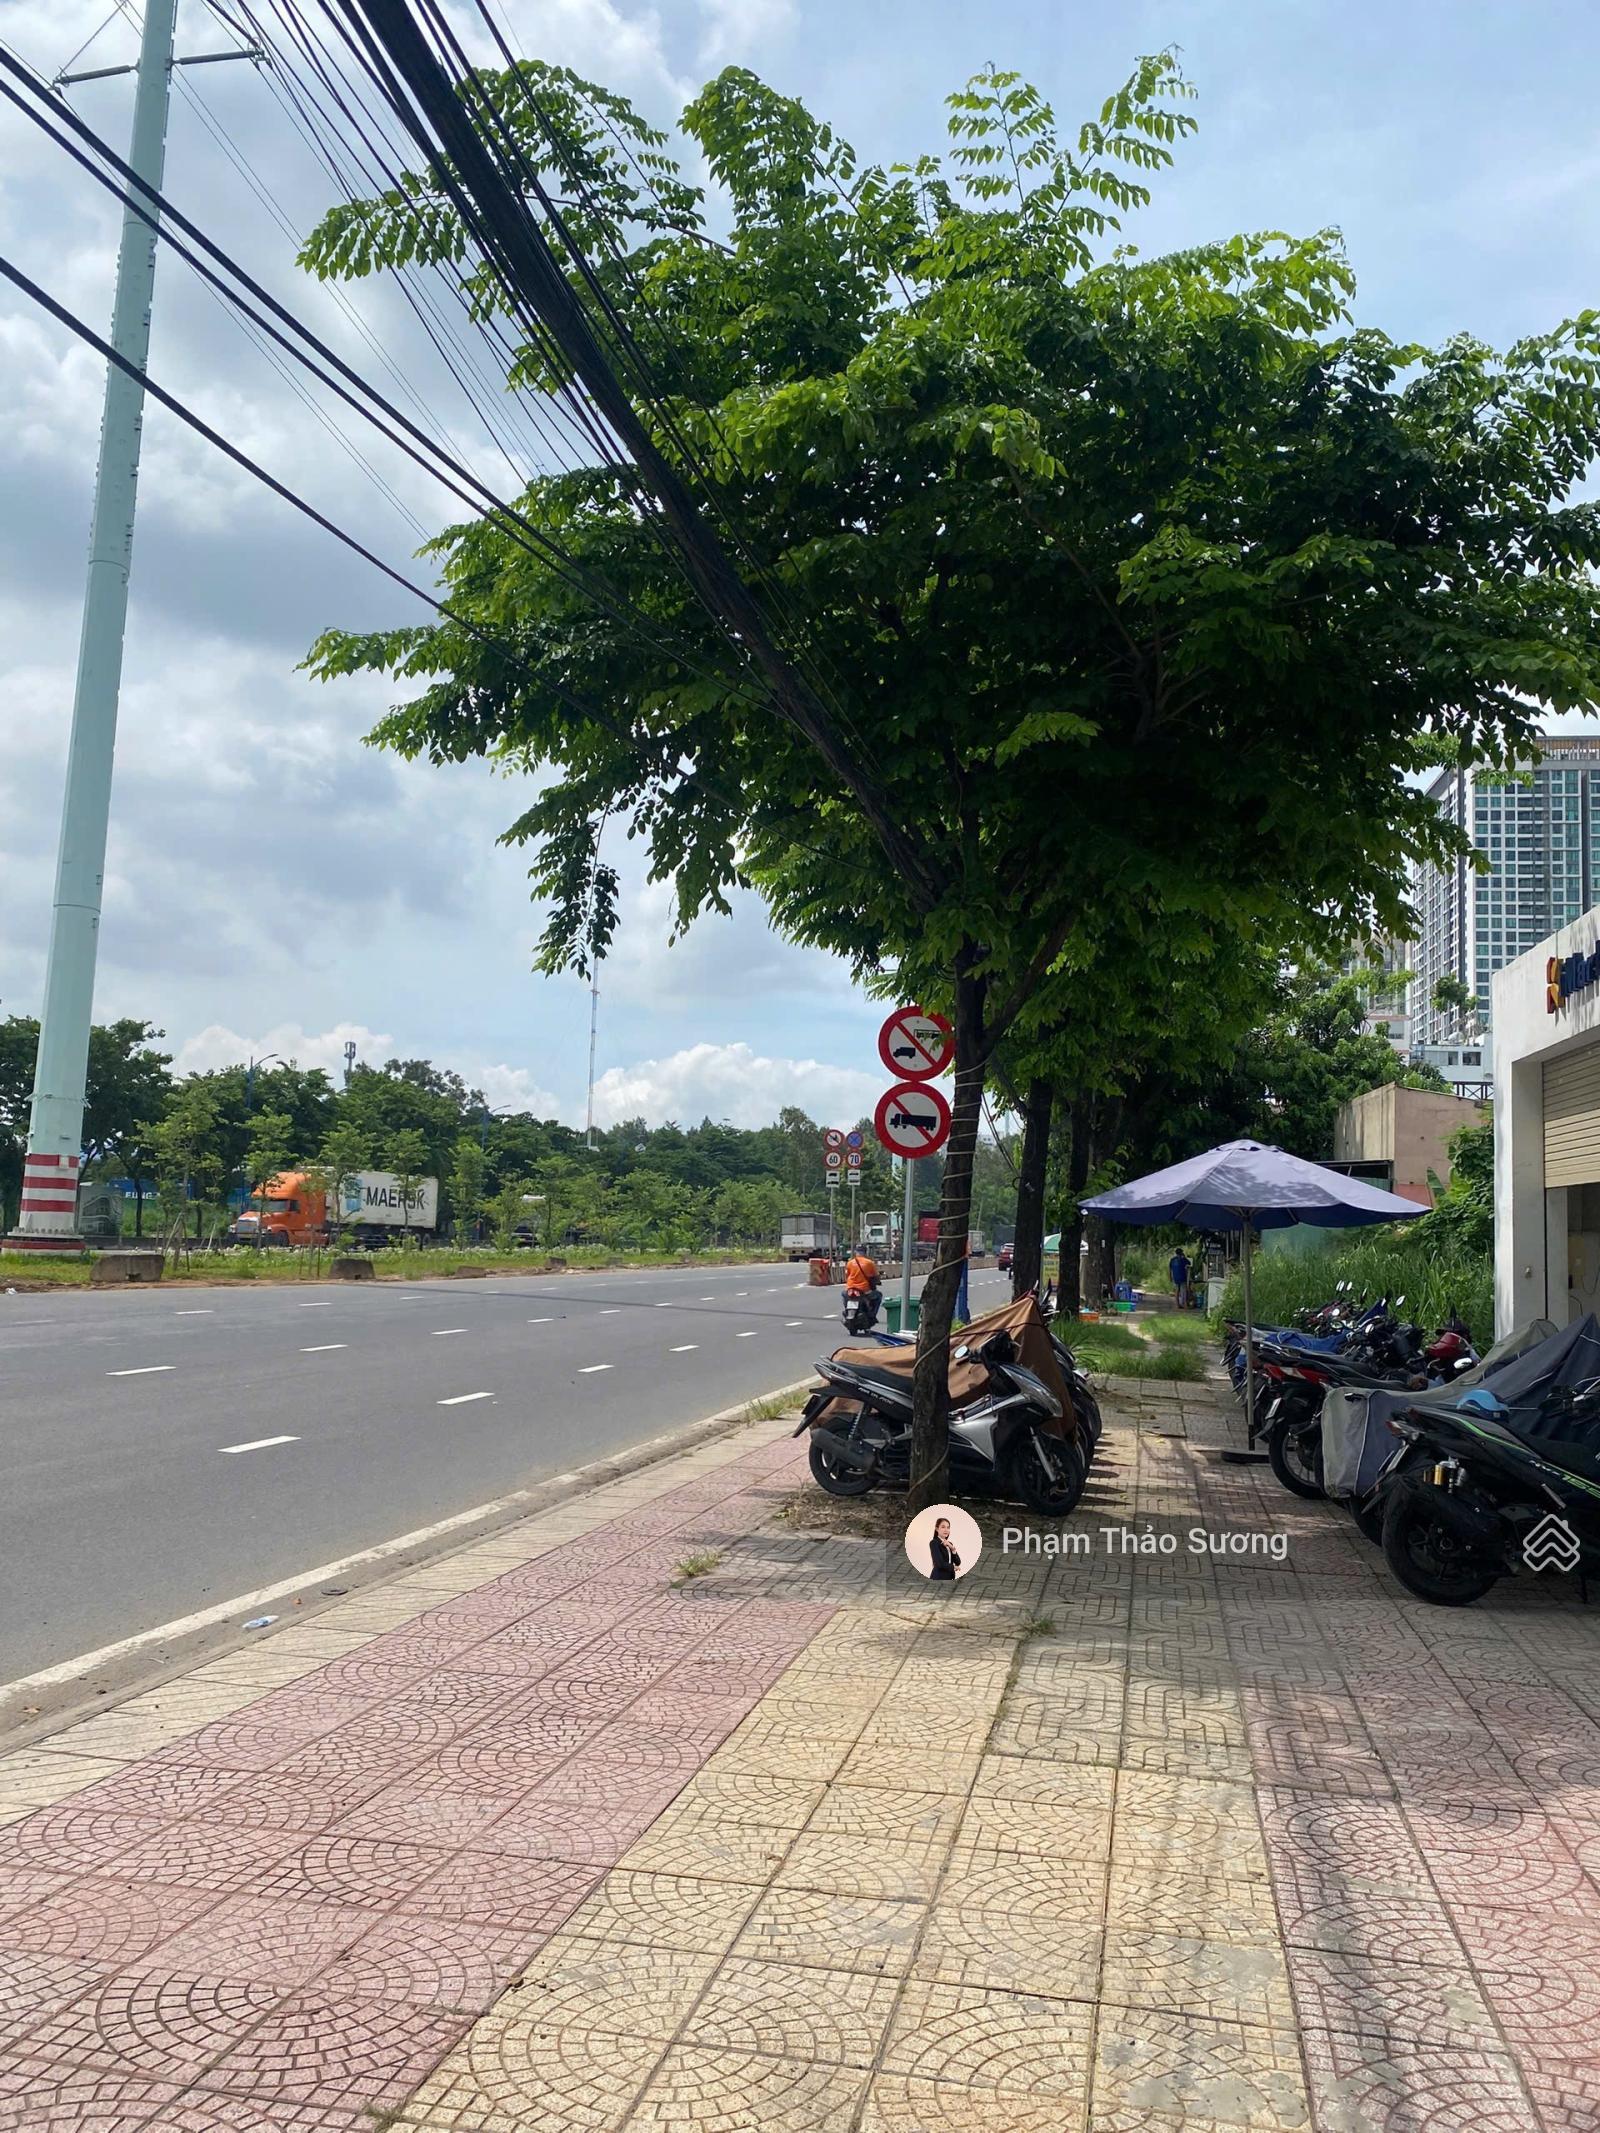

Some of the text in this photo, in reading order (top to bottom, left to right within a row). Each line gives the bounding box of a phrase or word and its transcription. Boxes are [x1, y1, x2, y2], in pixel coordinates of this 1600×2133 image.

[829, 1155, 839, 1165] 60
[850, 1154, 860, 1165] 70
[366, 1186, 425, 1210] MAERSK
